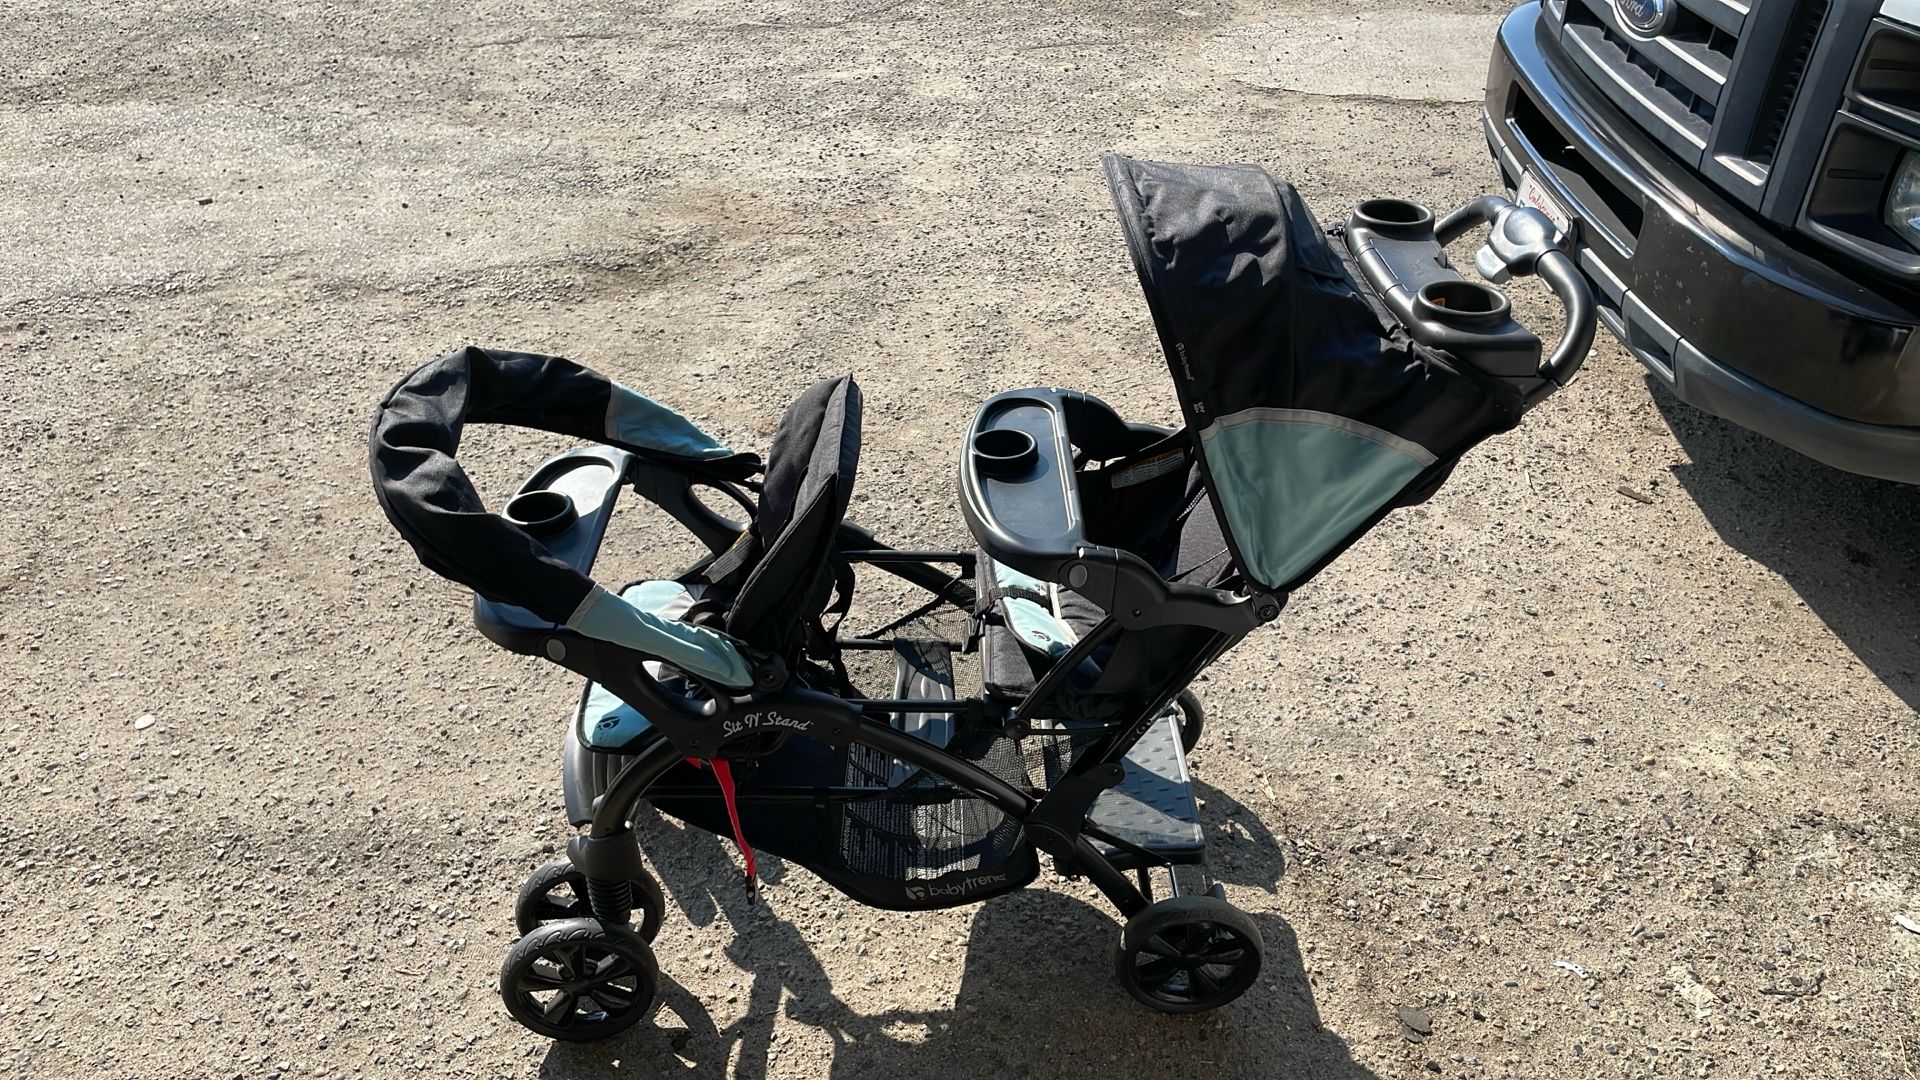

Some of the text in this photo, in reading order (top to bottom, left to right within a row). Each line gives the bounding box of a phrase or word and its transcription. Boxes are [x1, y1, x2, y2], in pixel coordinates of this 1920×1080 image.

[1620, 0, 1647, 18] ord
[723, 720, 743, 738] Sit
[762, 711, 810, 731] Stand
